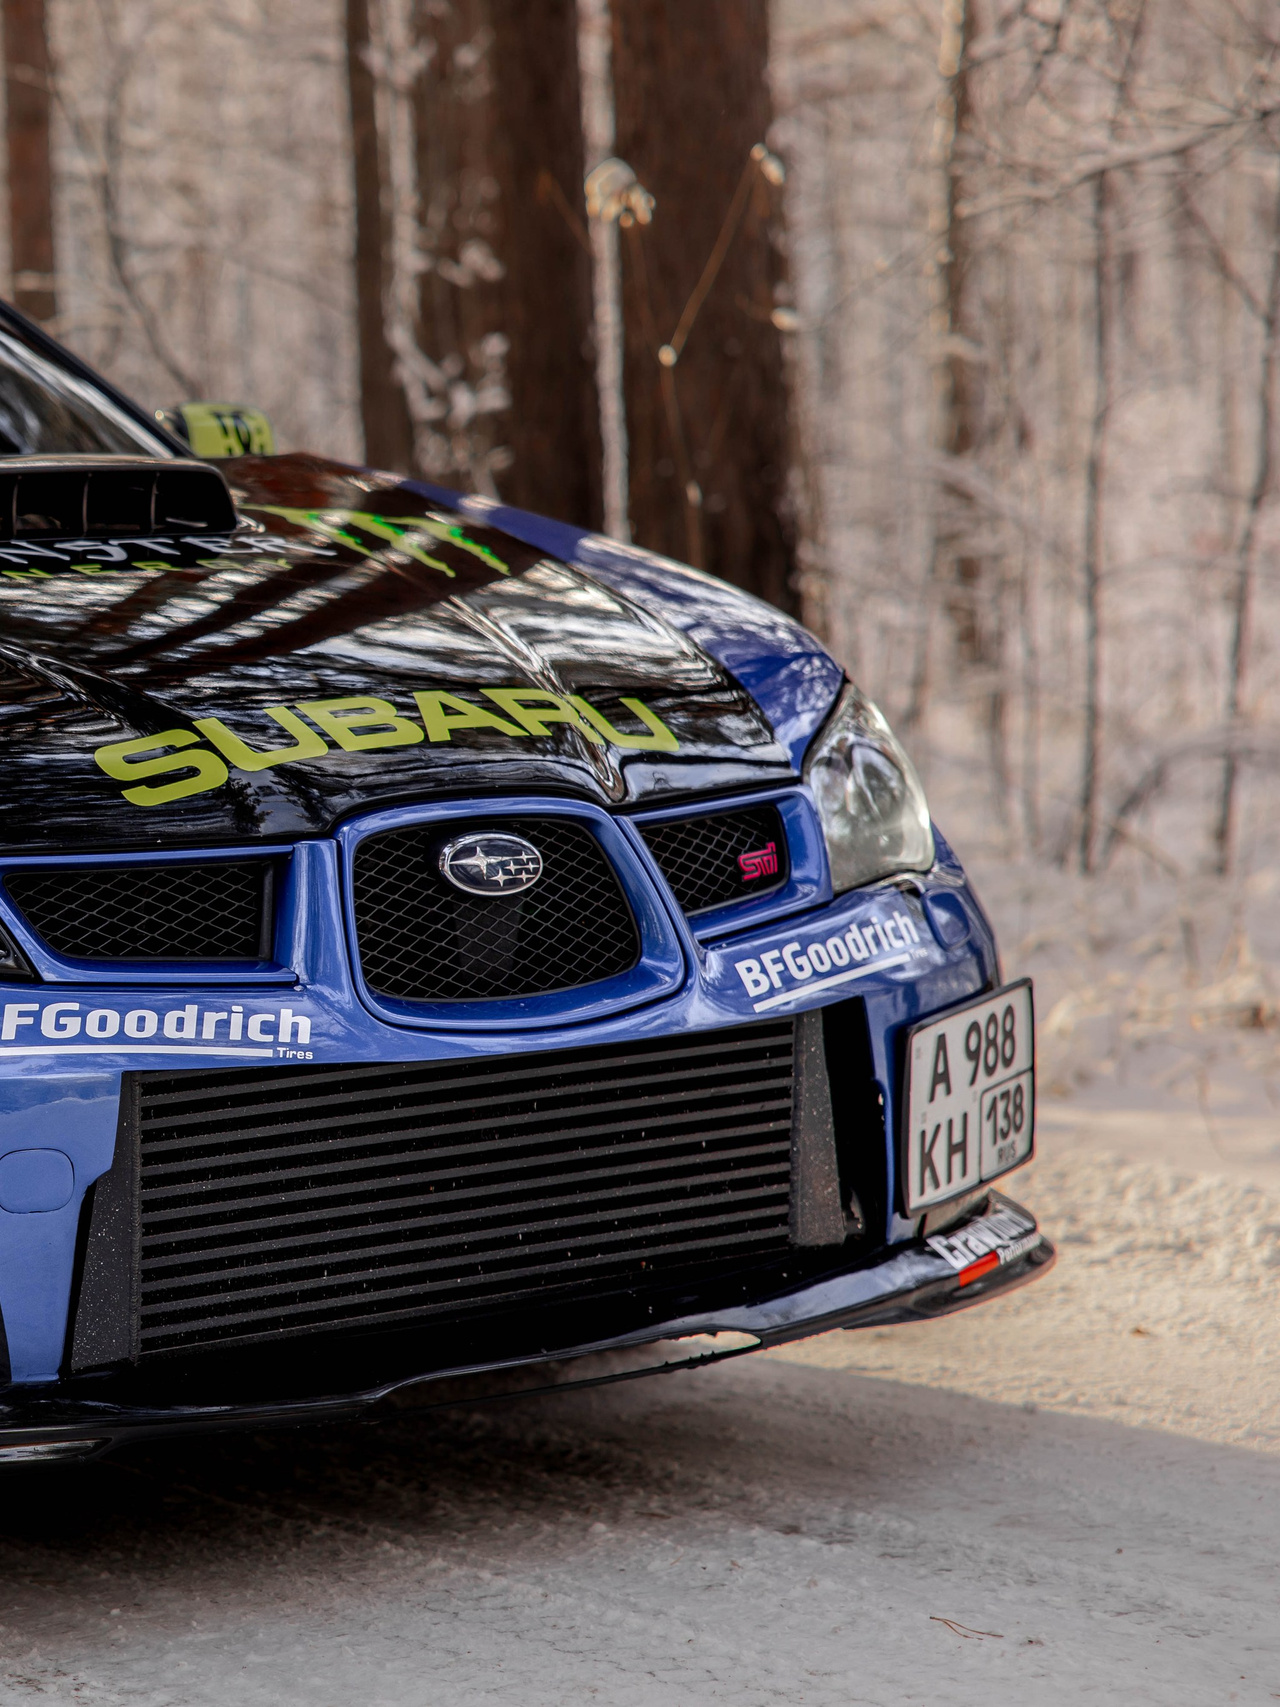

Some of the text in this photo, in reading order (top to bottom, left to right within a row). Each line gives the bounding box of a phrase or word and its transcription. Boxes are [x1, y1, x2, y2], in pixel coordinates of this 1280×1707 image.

[94, 688, 680, 807] SUBARU
[734, 910, 920, 998] BFGoodrich
[276, 1047, 314, 1061] Tires
[965, 1003, 1017, 1087] 988
[985, 1082, 1024, 1148] 138
